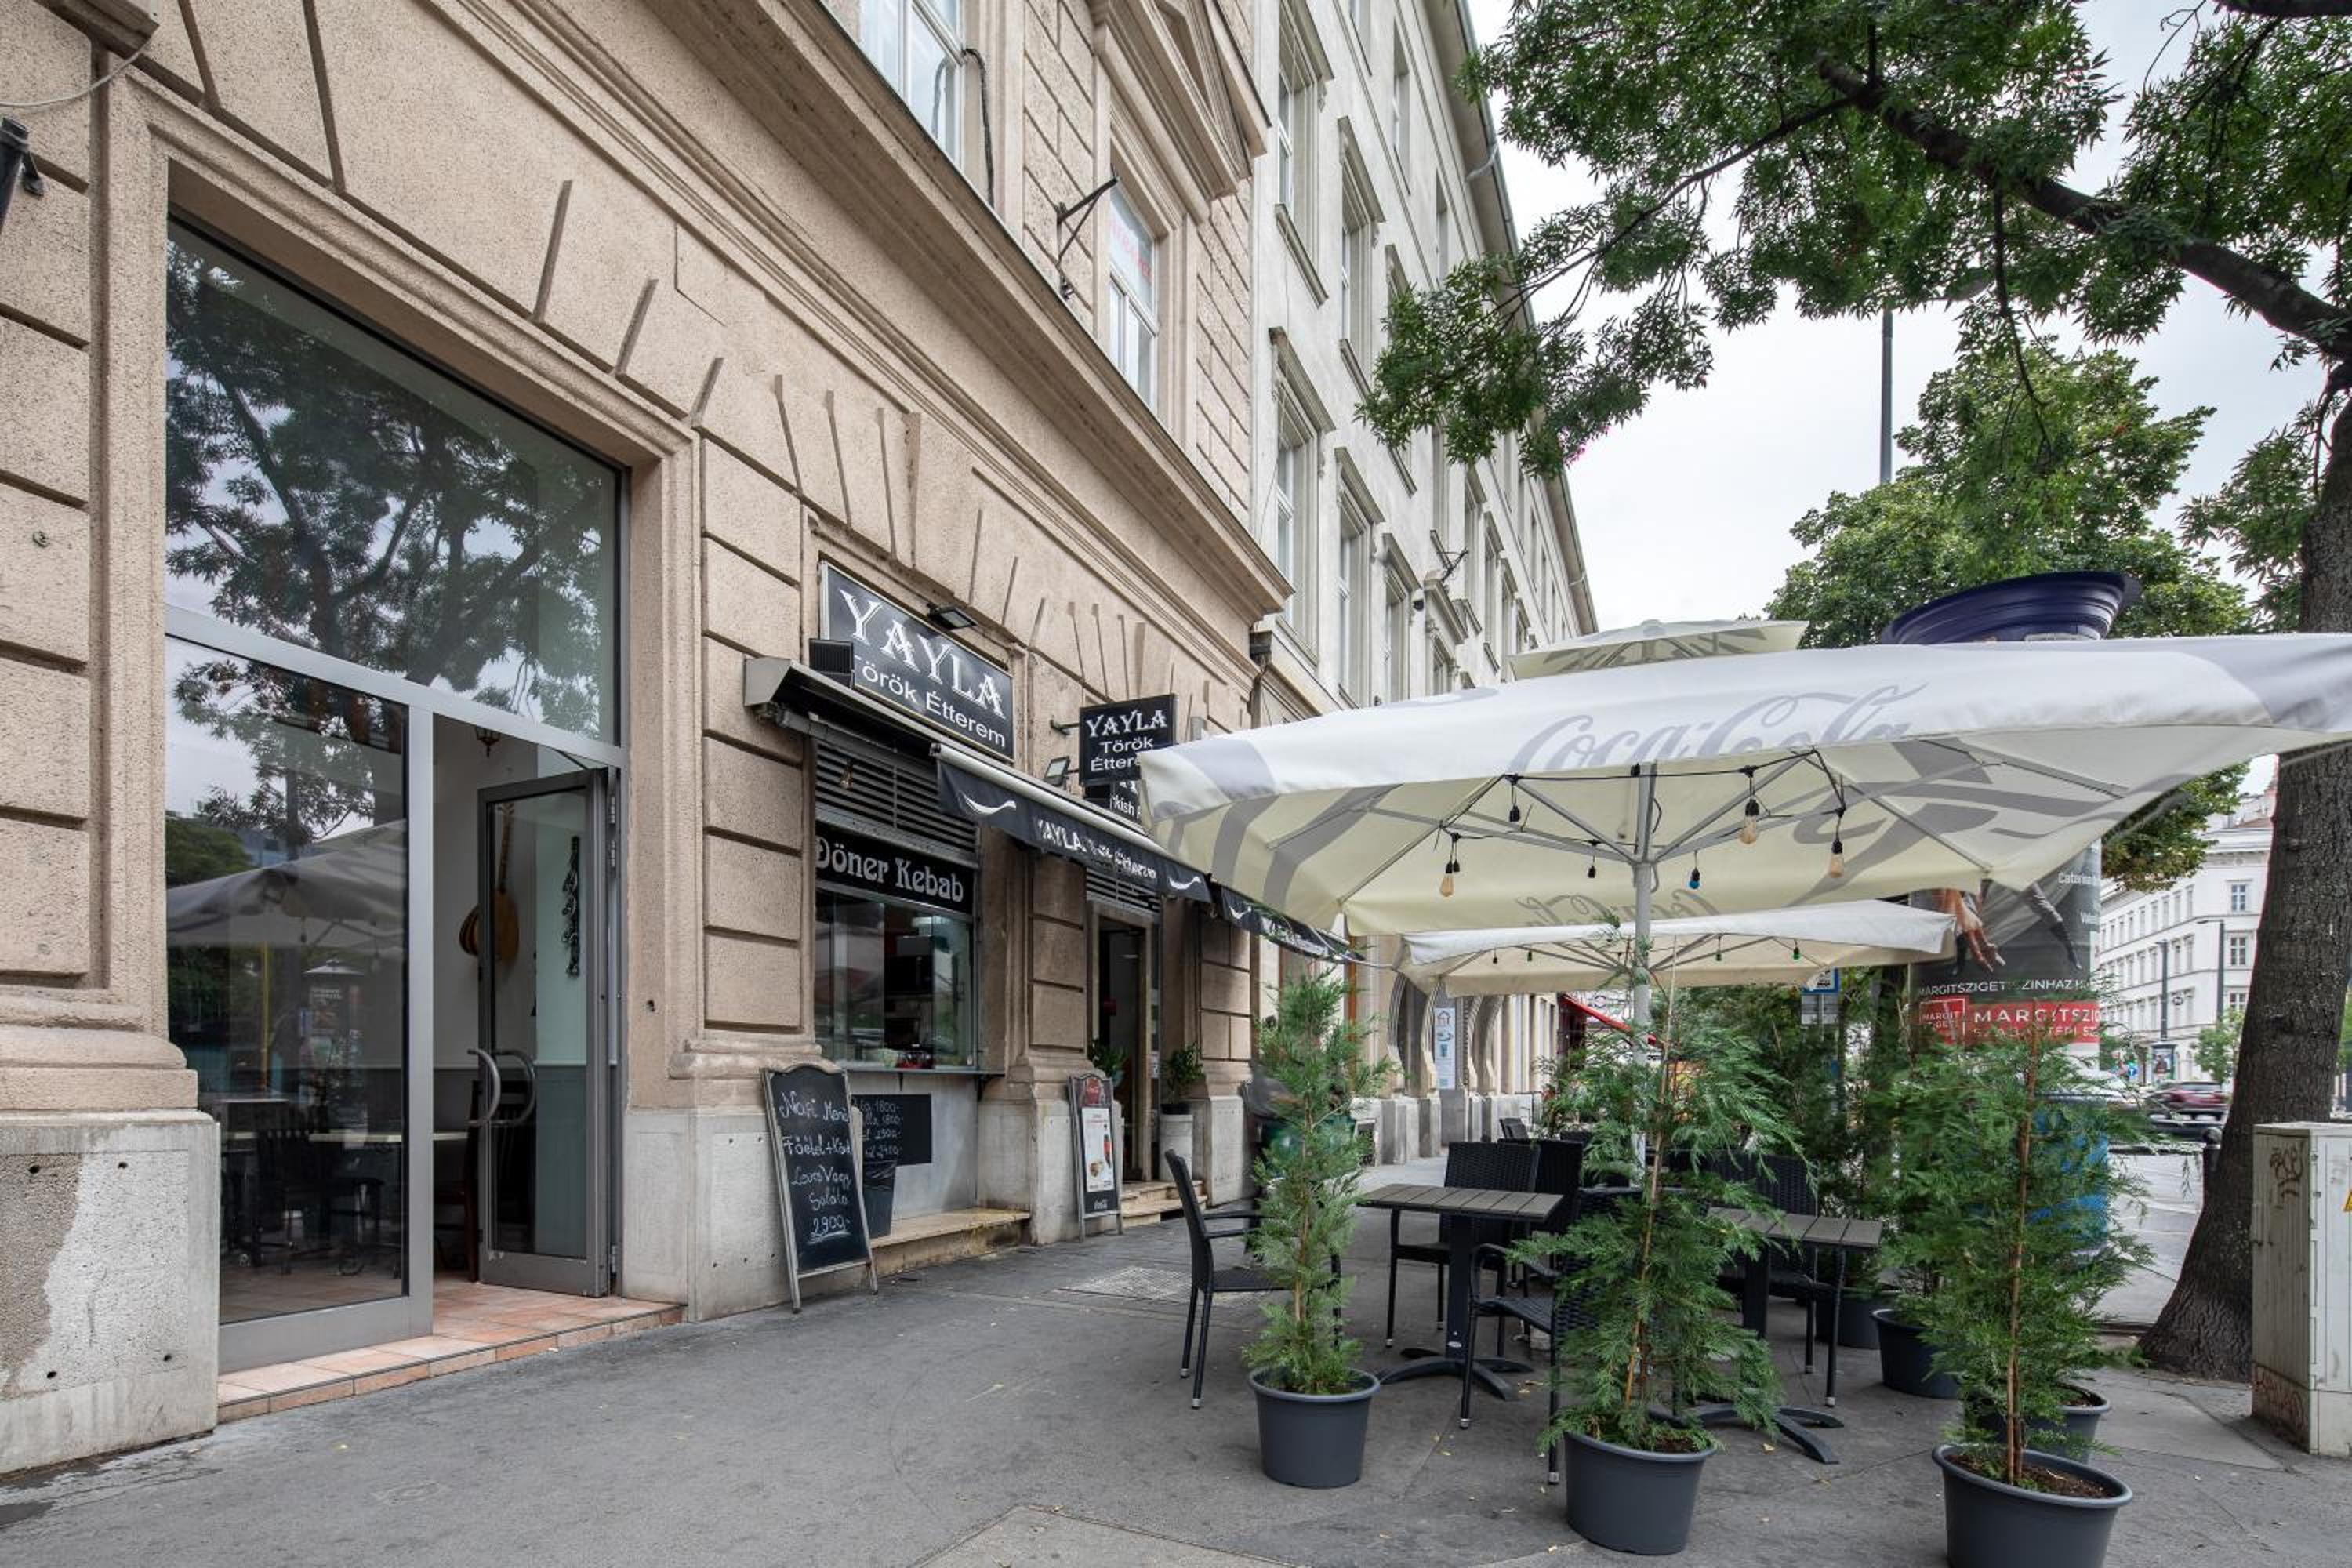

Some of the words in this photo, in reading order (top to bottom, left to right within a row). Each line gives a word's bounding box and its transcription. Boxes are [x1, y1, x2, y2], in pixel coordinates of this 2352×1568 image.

[840, 589, 1007, 720] YAYLA
[854, 655, 919, 704] örök
[926, 690, 1006, 747] Étterem
[1086, 709, 1168, 738] YAYLA
[1091, 756, 1142, 772] Éttere
[1098, 736, 1154, 753] Török
[815, 835, 890, 884] Döner
[895, 857, 964, 902] Kebab
